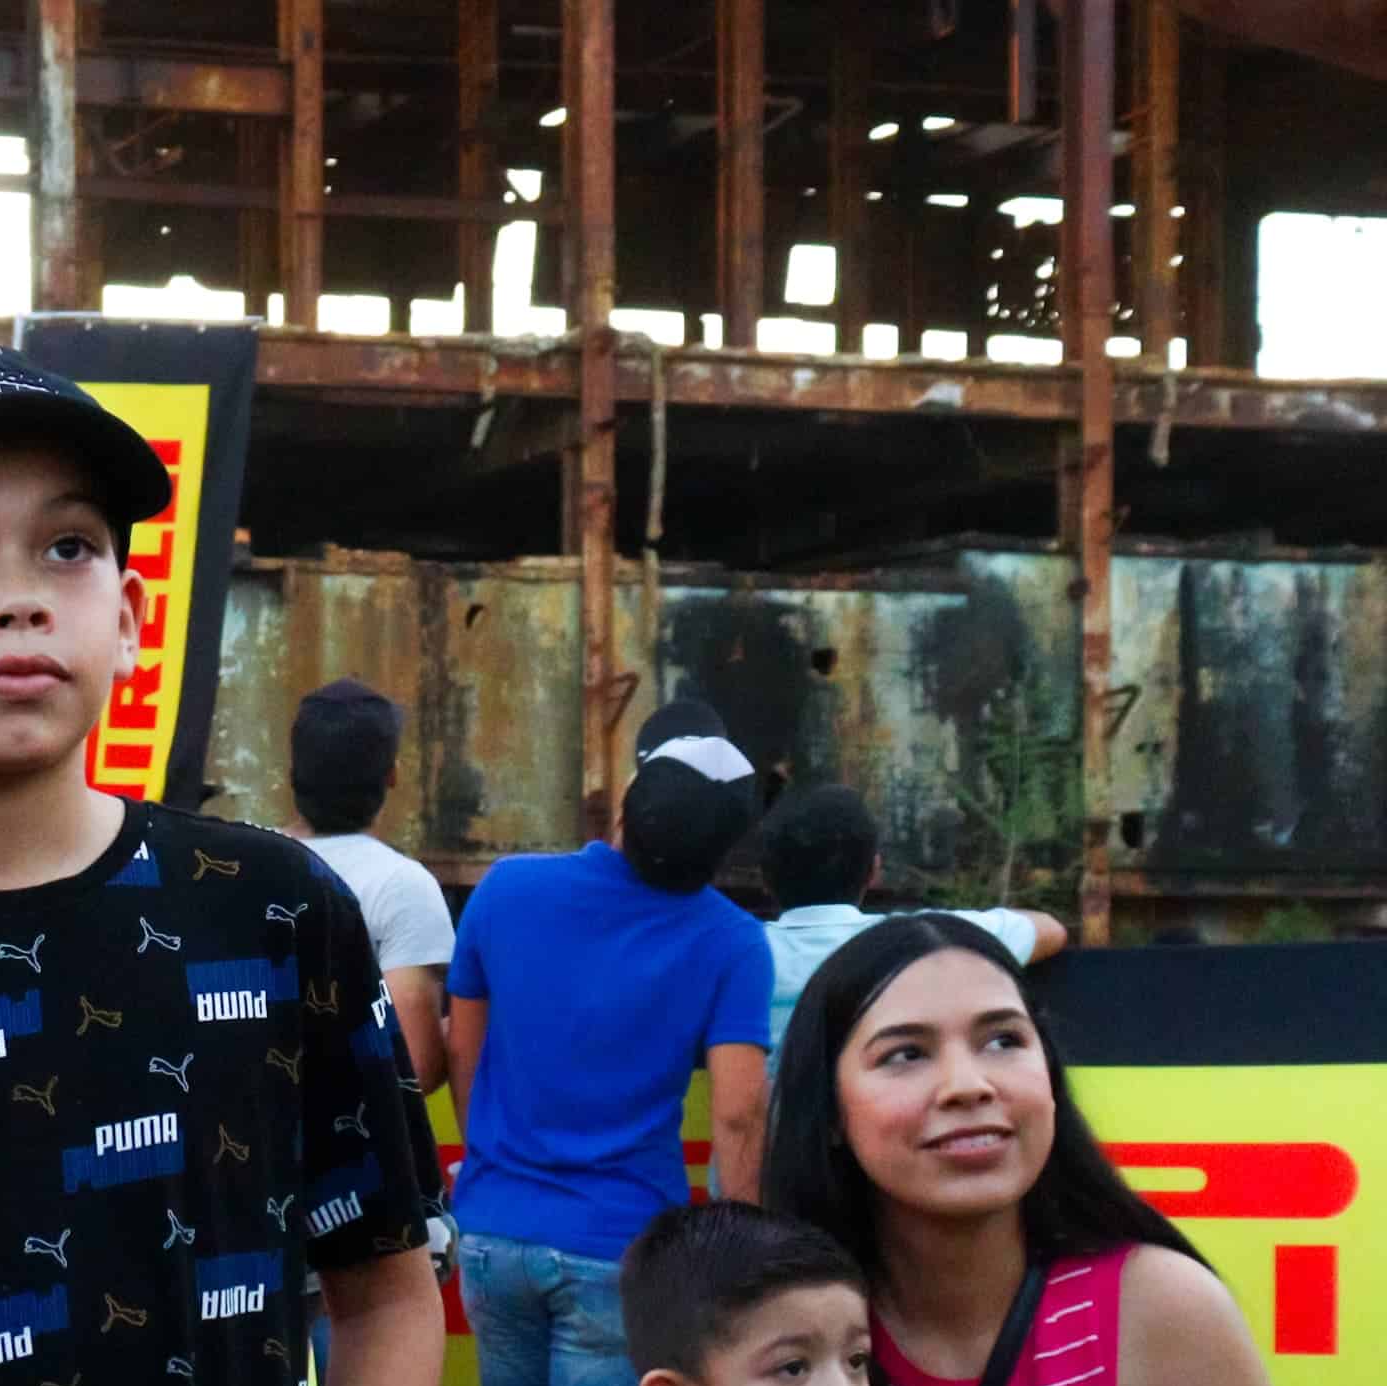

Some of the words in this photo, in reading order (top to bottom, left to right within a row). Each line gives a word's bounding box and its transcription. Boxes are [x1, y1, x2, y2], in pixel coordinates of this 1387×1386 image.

[196, 990, 268, 1022] PUMA
[95, 1112, 178, 1156] PUMA
[201, 1283, 265, 1321] PUMA
